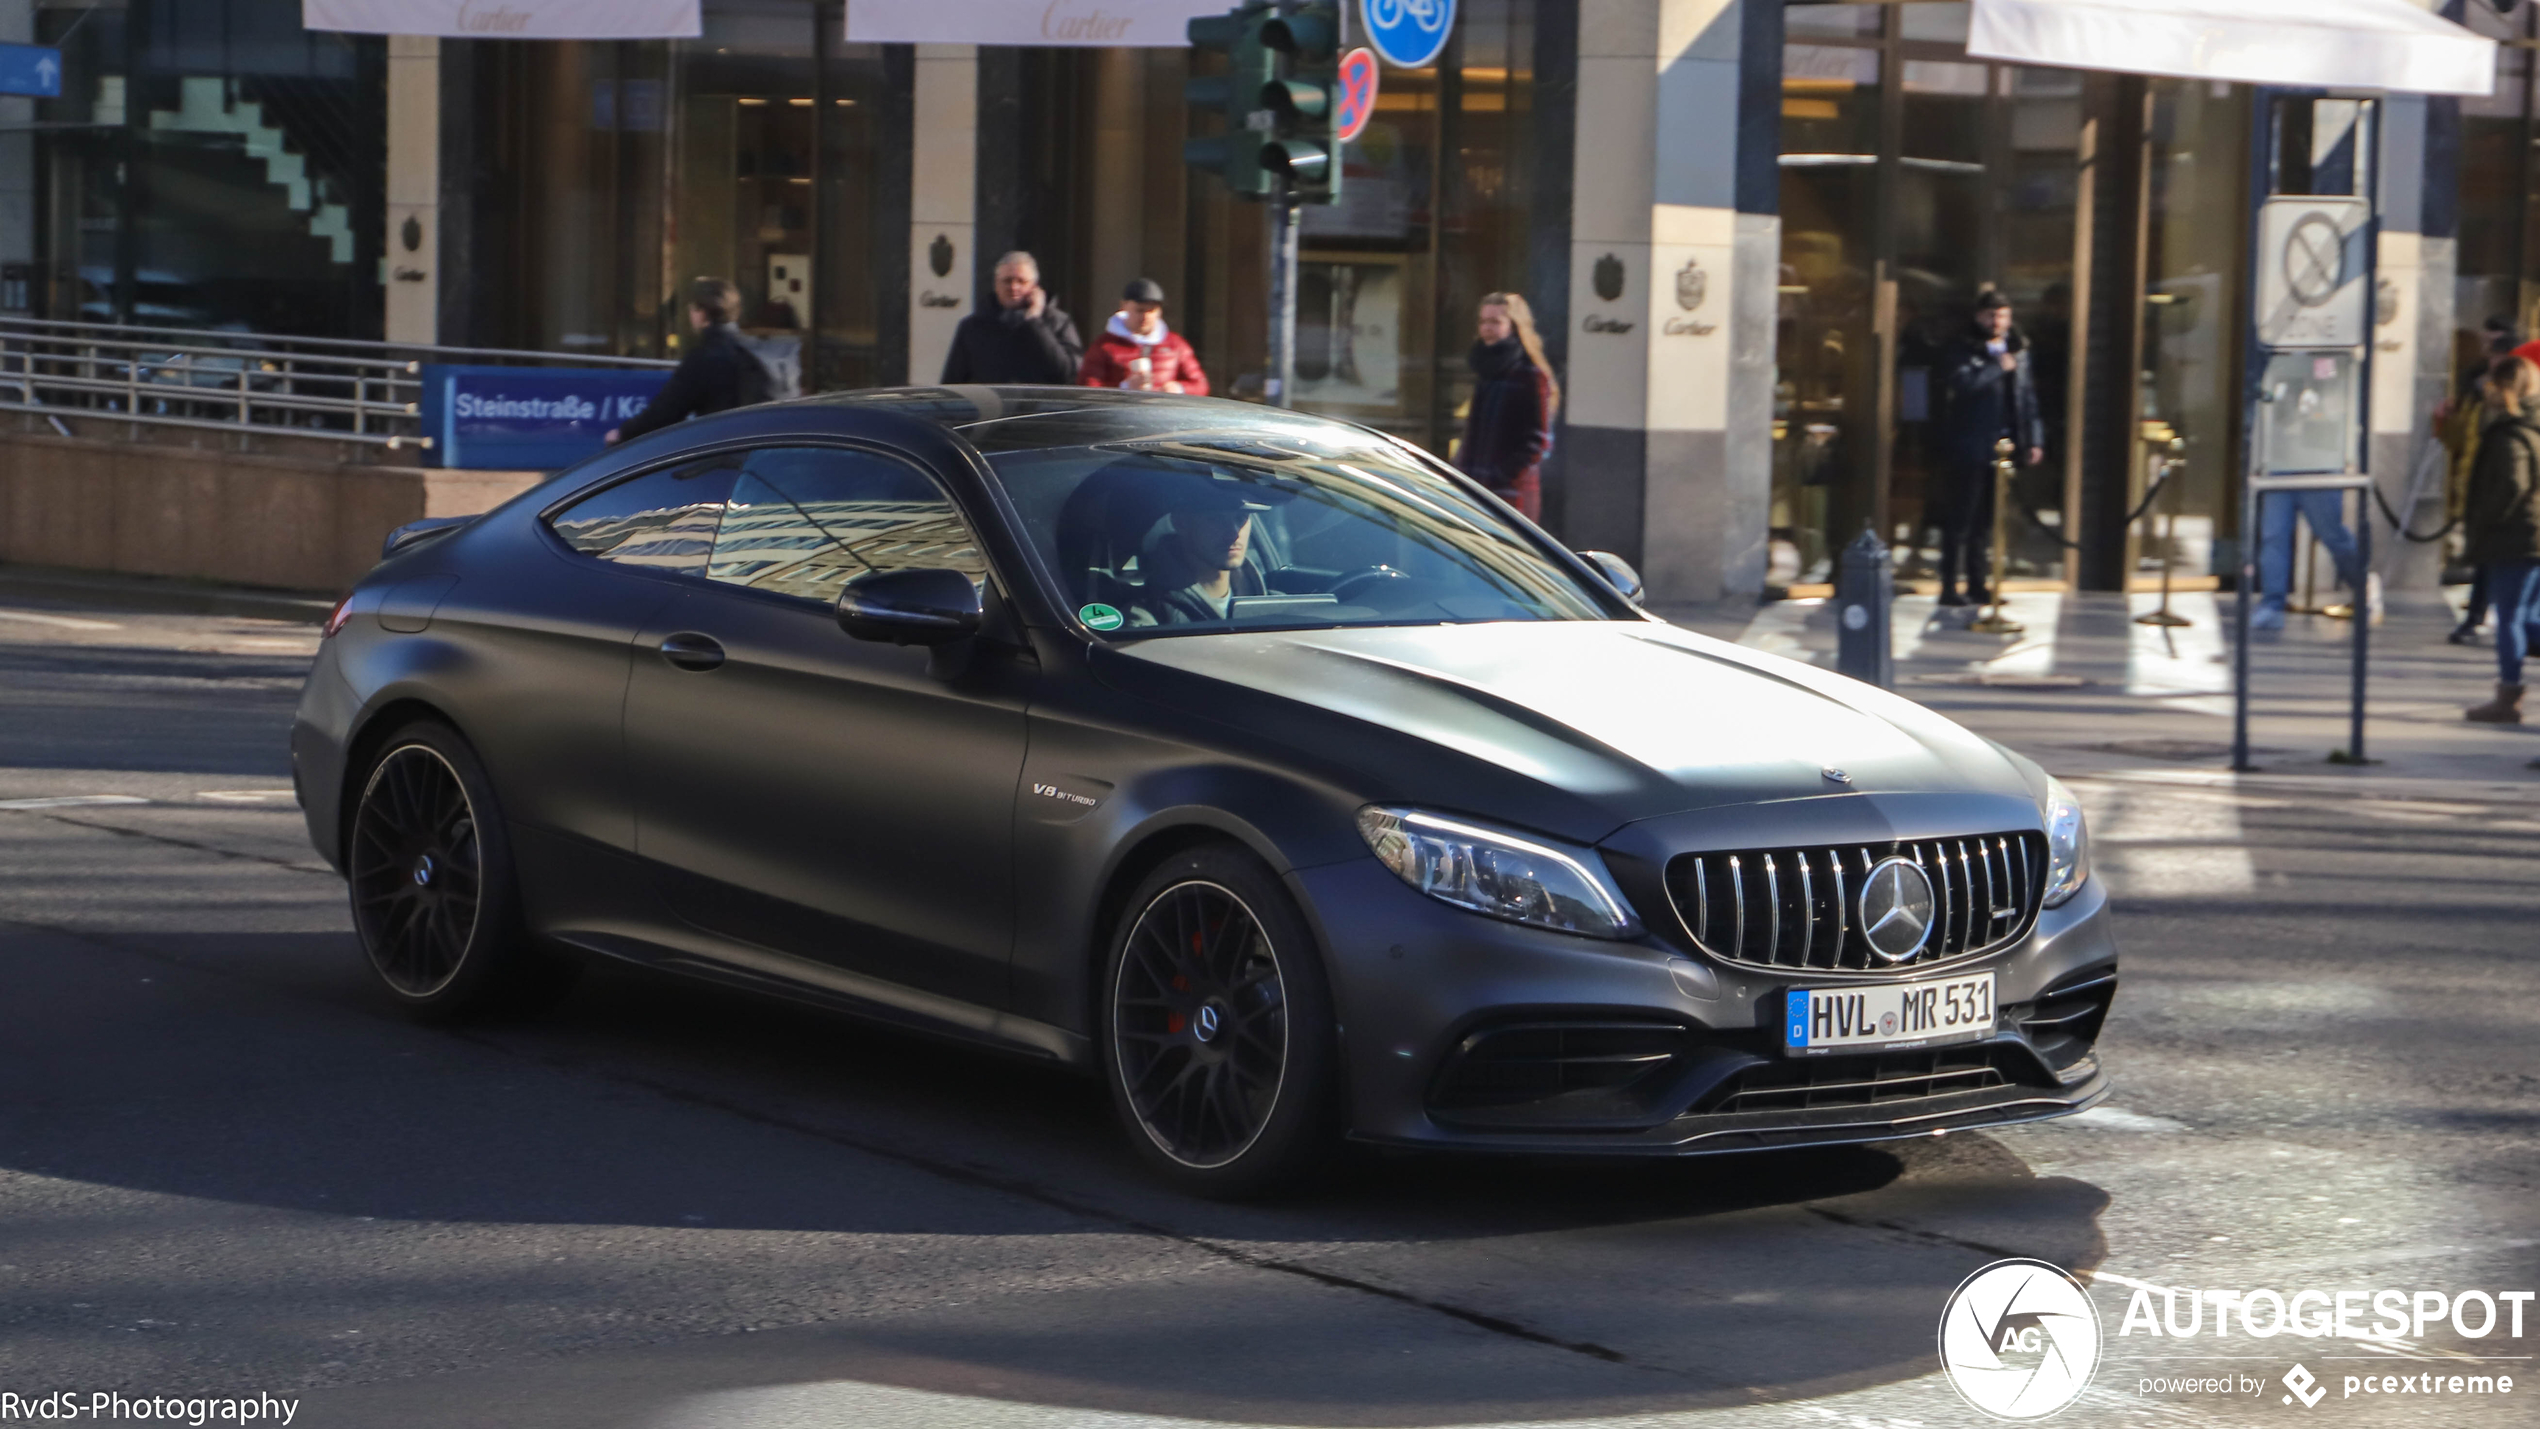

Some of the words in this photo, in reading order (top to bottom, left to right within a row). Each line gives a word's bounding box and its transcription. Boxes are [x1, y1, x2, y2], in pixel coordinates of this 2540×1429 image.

[456, 0, 533, 32] Cartier
[1040, 0, 1134, 40] Cartier
[1582, 313, 1636, 334] Cartier
[1662, 316, 1718, 336] Cartier
[455, 393, 595, 419] Steinstraße
[1033, 783, 1058, 797] V8
[1056, 791, 1097, 806] BITURBO
[1812, 993, 1876, 1039] HVL
[1901, 986, 1937, 1033] MR
[1945, 979, 1992, 1026] 531
[1793, 1025, 1803, 1038] D
